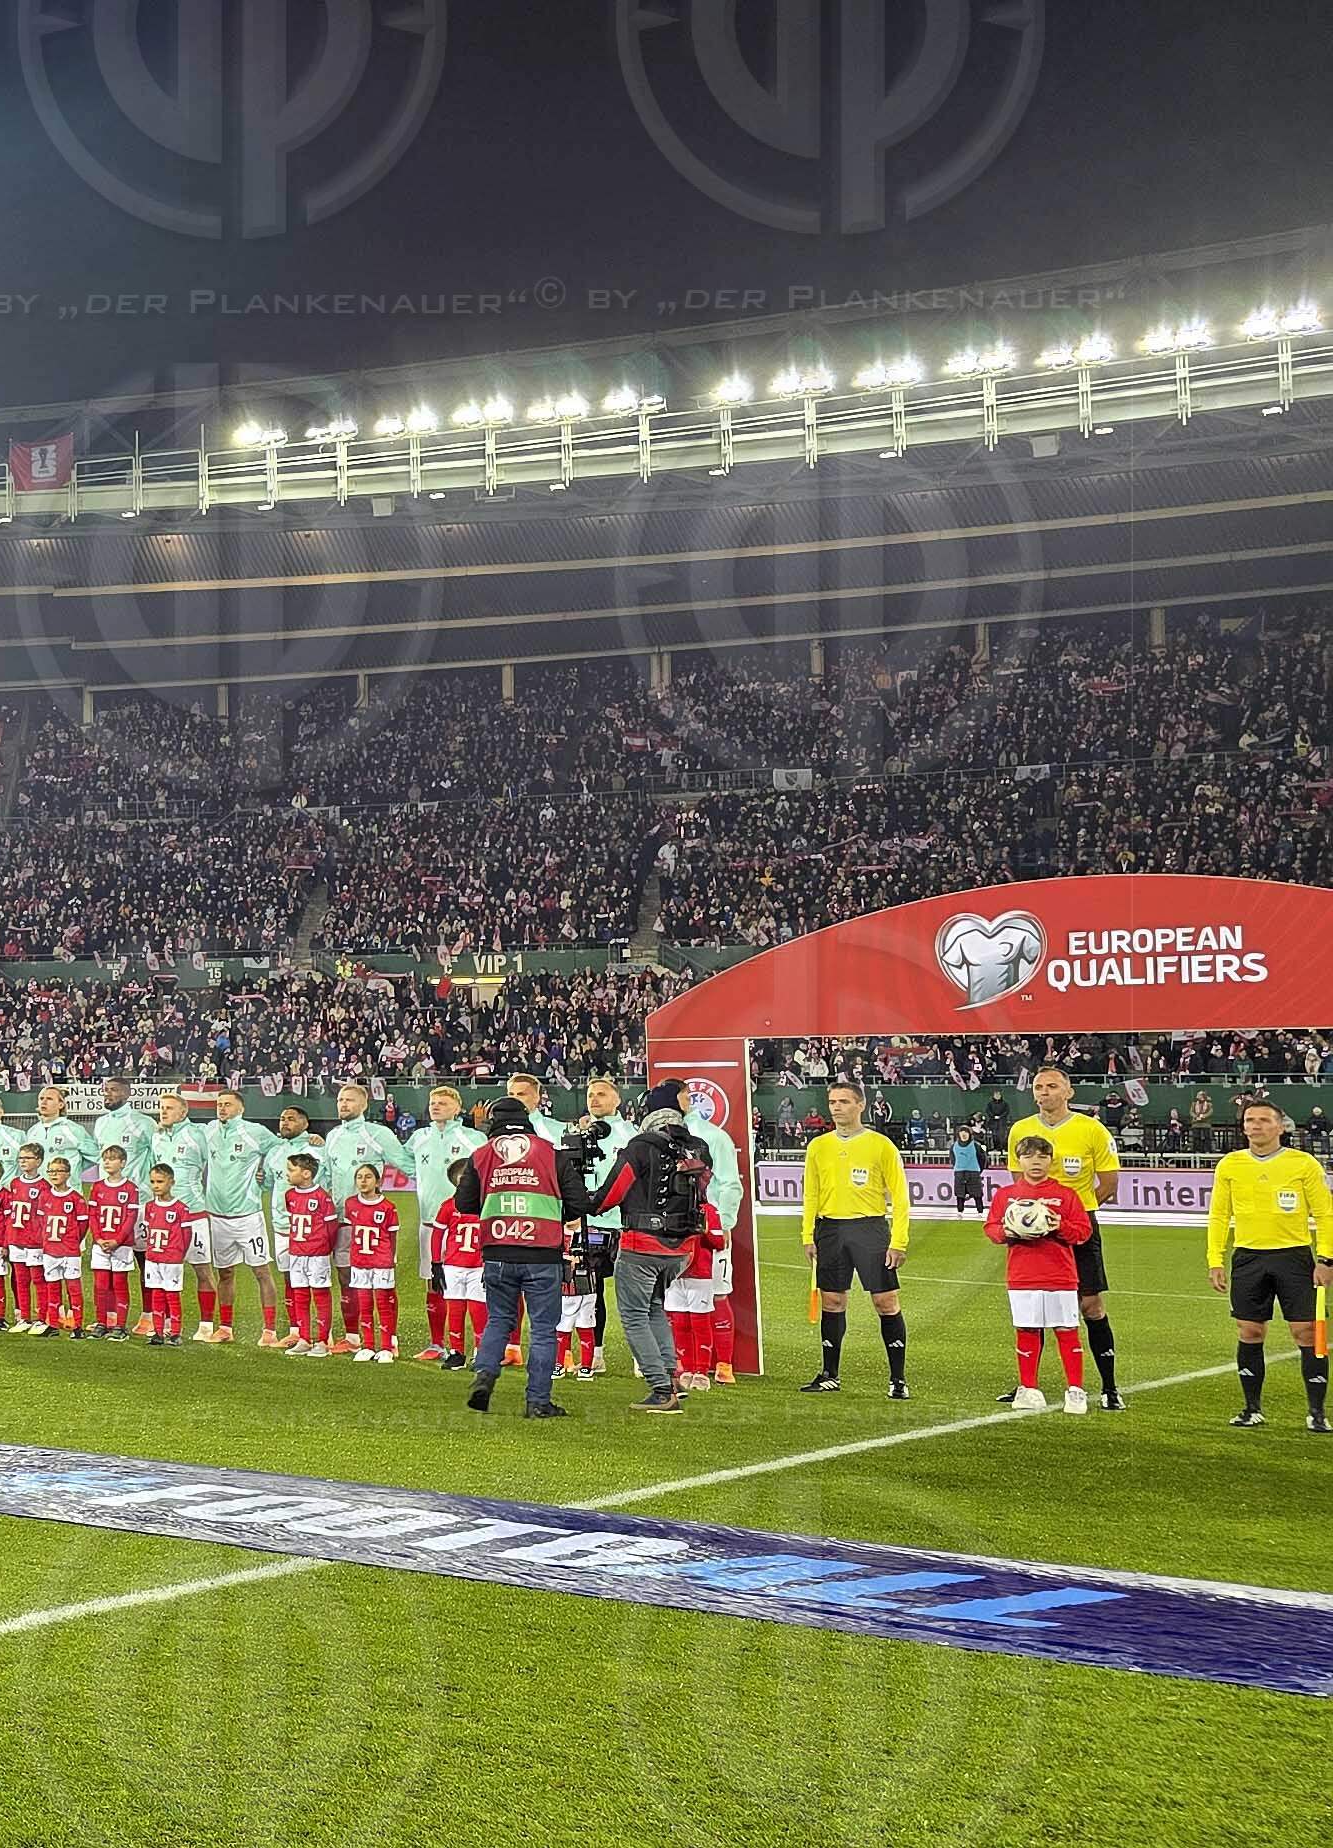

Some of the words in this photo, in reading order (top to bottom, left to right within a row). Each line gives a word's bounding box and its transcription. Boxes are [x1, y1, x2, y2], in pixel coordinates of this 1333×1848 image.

[1068, 925, 1243, 956] EUROPEAN
[207, 967, 222, 979] 15
[472, 953, 507, 974] VIP
[514, 952, 524, 973] 1
[1046, 952, 1269, 992] QUALIFIERS
[688, 1082, 715, 1096] EFA
[493, 1168, 534, 1177] EUROPEAN
[852, 1168, 868, 1176] FIFA
[12, 1200, 31, 1229] T
[500, 1196, 527, 1214] HB
[45, 1215, 67, 1242] T
[99, 1204, 121, 1232] T
[292, 1213, 312, 1242] T
[491, 1218, 535, 1241] 042
[149, 1228, 169, 1252] T
[248, 1236, 264, 1256] 19
[354, 1225, 380, 1255] T
[454, 1222, 480, 1253] T
